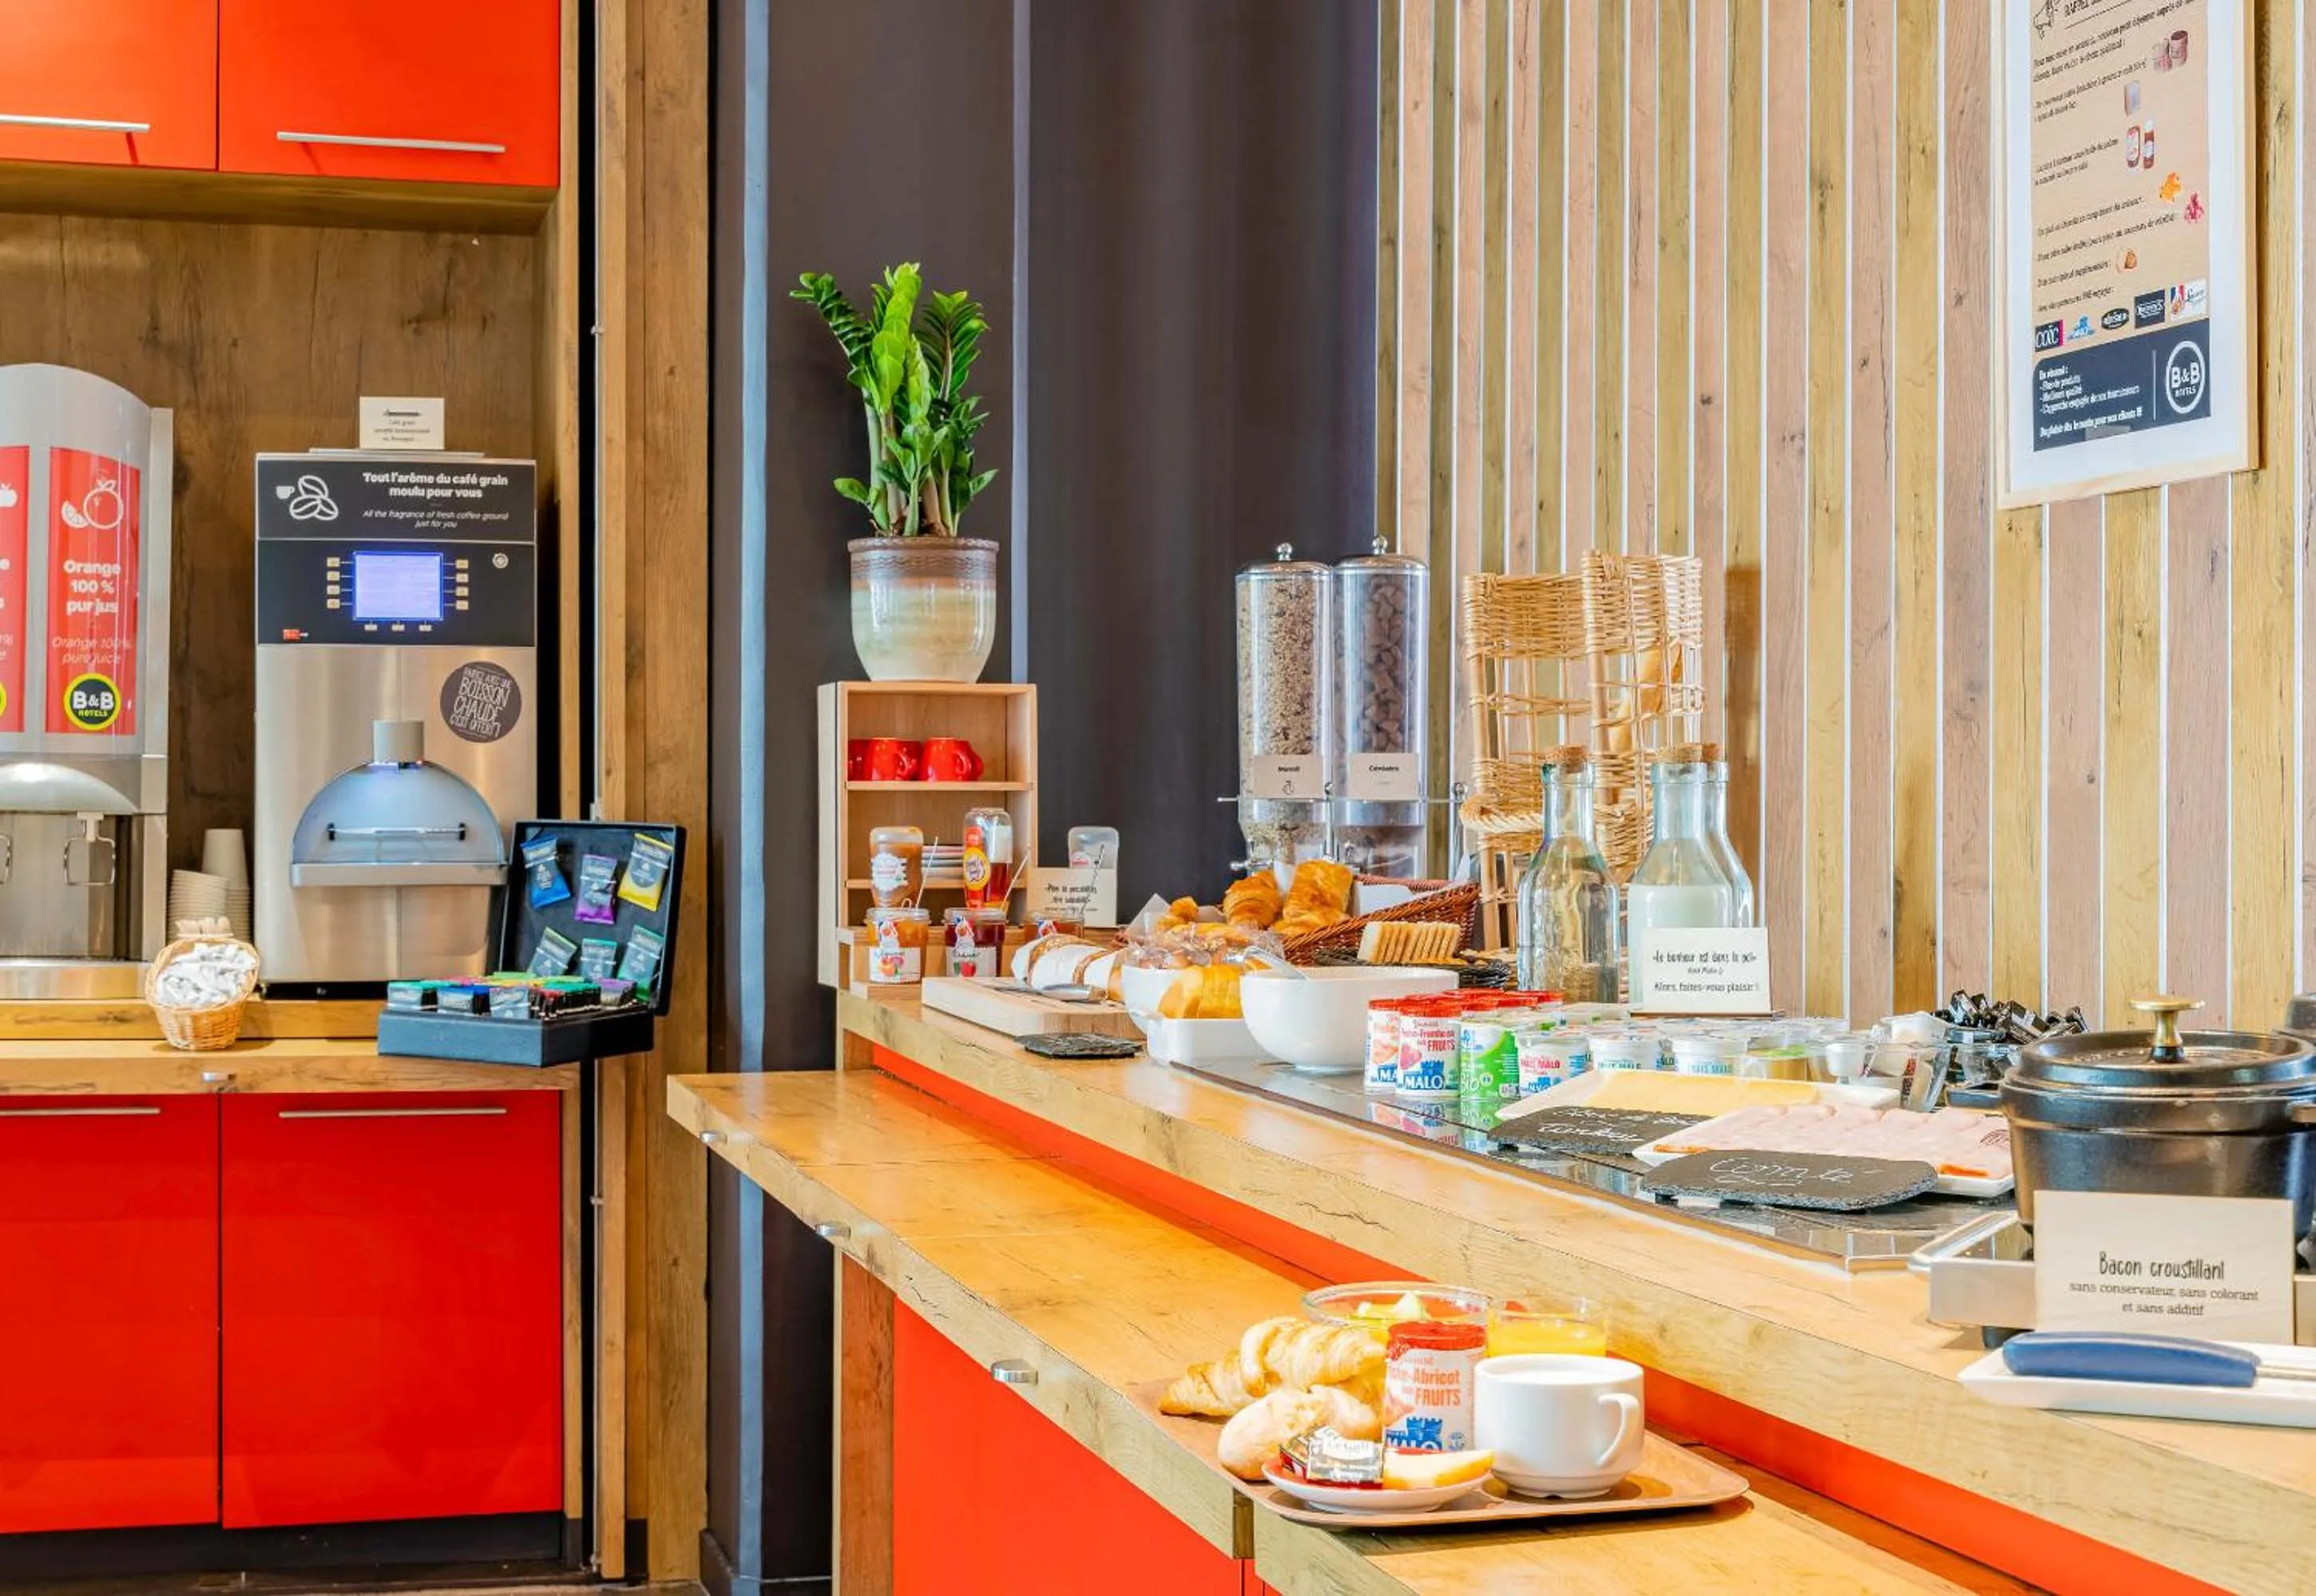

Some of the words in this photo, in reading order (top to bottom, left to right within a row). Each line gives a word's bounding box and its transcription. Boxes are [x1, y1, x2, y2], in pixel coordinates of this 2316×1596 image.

[2171, 362, 2200, 388] B&B
[363, 472, 390, 482] Tout
[391, 472, 434, 484] l'arôme
[436, 473, 451, 484] du
[453, 473, 478, 485] café
[479, 474, 508, 487] grain
[389, 486, 425, 497] moulu
[426, 489, 454, 499] pour
[455, 489, 482, 497] vous
[389, 510, 424, 520] fragrance
[64, 560, 121, 576] Orange
[71, 580, 98, 592] 100
[101, 580, 115, 593] %
[67, 600, 93, 616] pur
[94, 598, 118, 616] jus
[52, 636, 97, 651] Orange
[62, 654, 92, 665] pure
[91, 654, 121, 666] juice
[459, 677, 511, 707] BOISSON
[73, 691, 114, 710] B&B
[454, 695, 503, 722] CHAUDE
[1727, 983, 1753, 993] plaisir
[1428, 1040, 1455, 1051] FRUITS
[1405, 1075, 1443, 1090] MALO
[2100, 1252, 2142, 1276] Bacon
[2151, 1259, 2224, 1280] croustillant
[2069, 1282, 2096, 1293] sans
[2179, 1288, 2207, 1298] sans
[2211, 1288, 2258, 1301] colorant
[2123, 1303, 2132, 1312] et
[2136, 1304, 2163, 1313] sans
[2167, 1303, 2204, 1316] additif
[1414, 1368, 1461, 1384] Abricot
[1416, 1388, 1461, 1406] FRUITS
